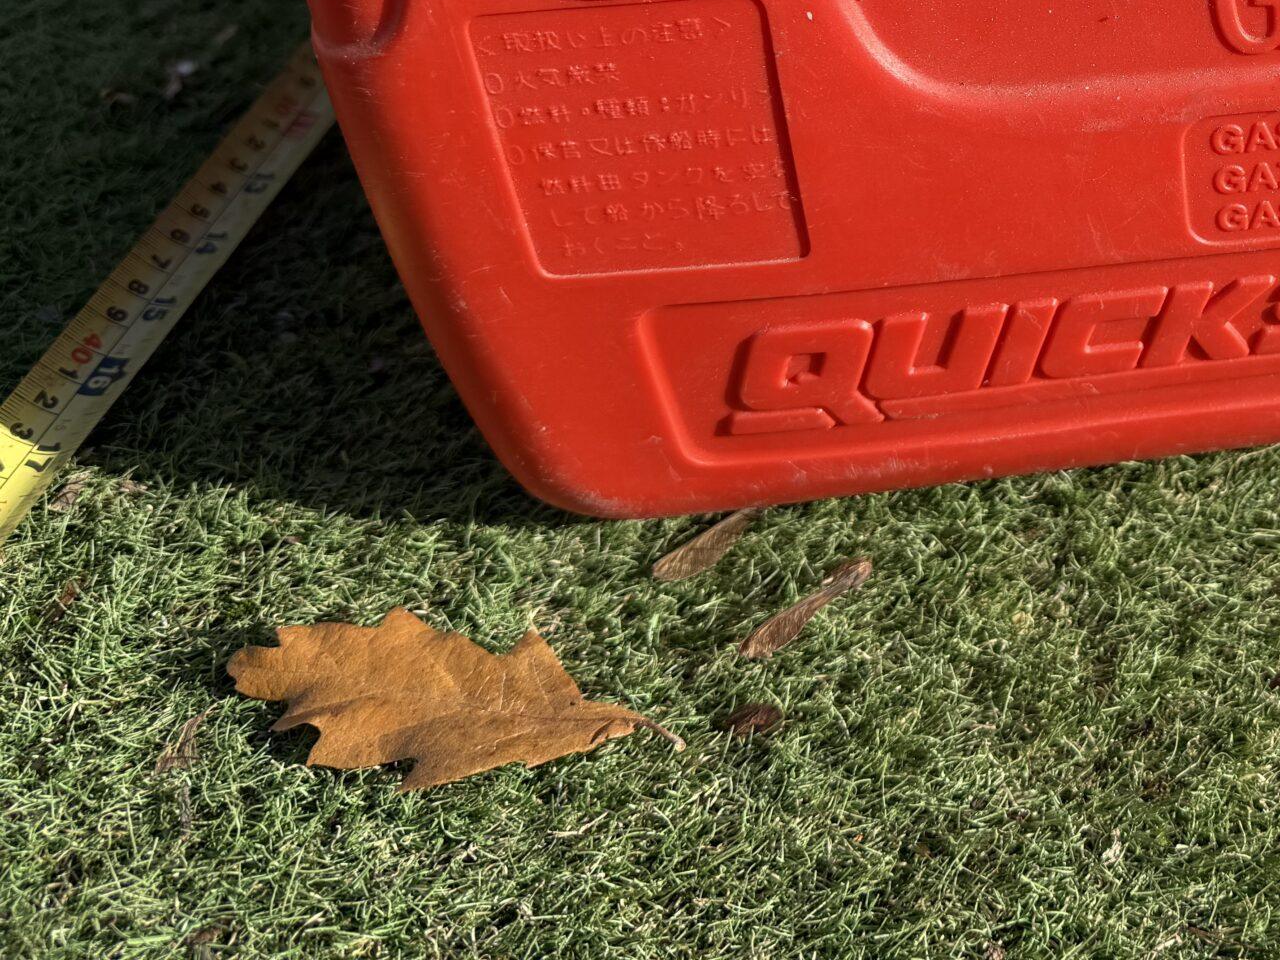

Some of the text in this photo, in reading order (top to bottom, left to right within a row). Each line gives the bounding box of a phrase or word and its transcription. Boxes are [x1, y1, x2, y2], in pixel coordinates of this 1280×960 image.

[190, 203, 209, 218] 5
[170, 228, 190, 244] 6
[151, 253, 173, 269] 7
[128, 280, 149, 295] 8
[106, 305, 128, 321] 9
[142, 295, 178, 321] 15
[71, 333, 102, 365] 40
[85, 363, 122, 391] 16
[33, 390, 58, 409] 2
[9, 422, 35, 441] 3
[24, 441, 62, 473] 17
